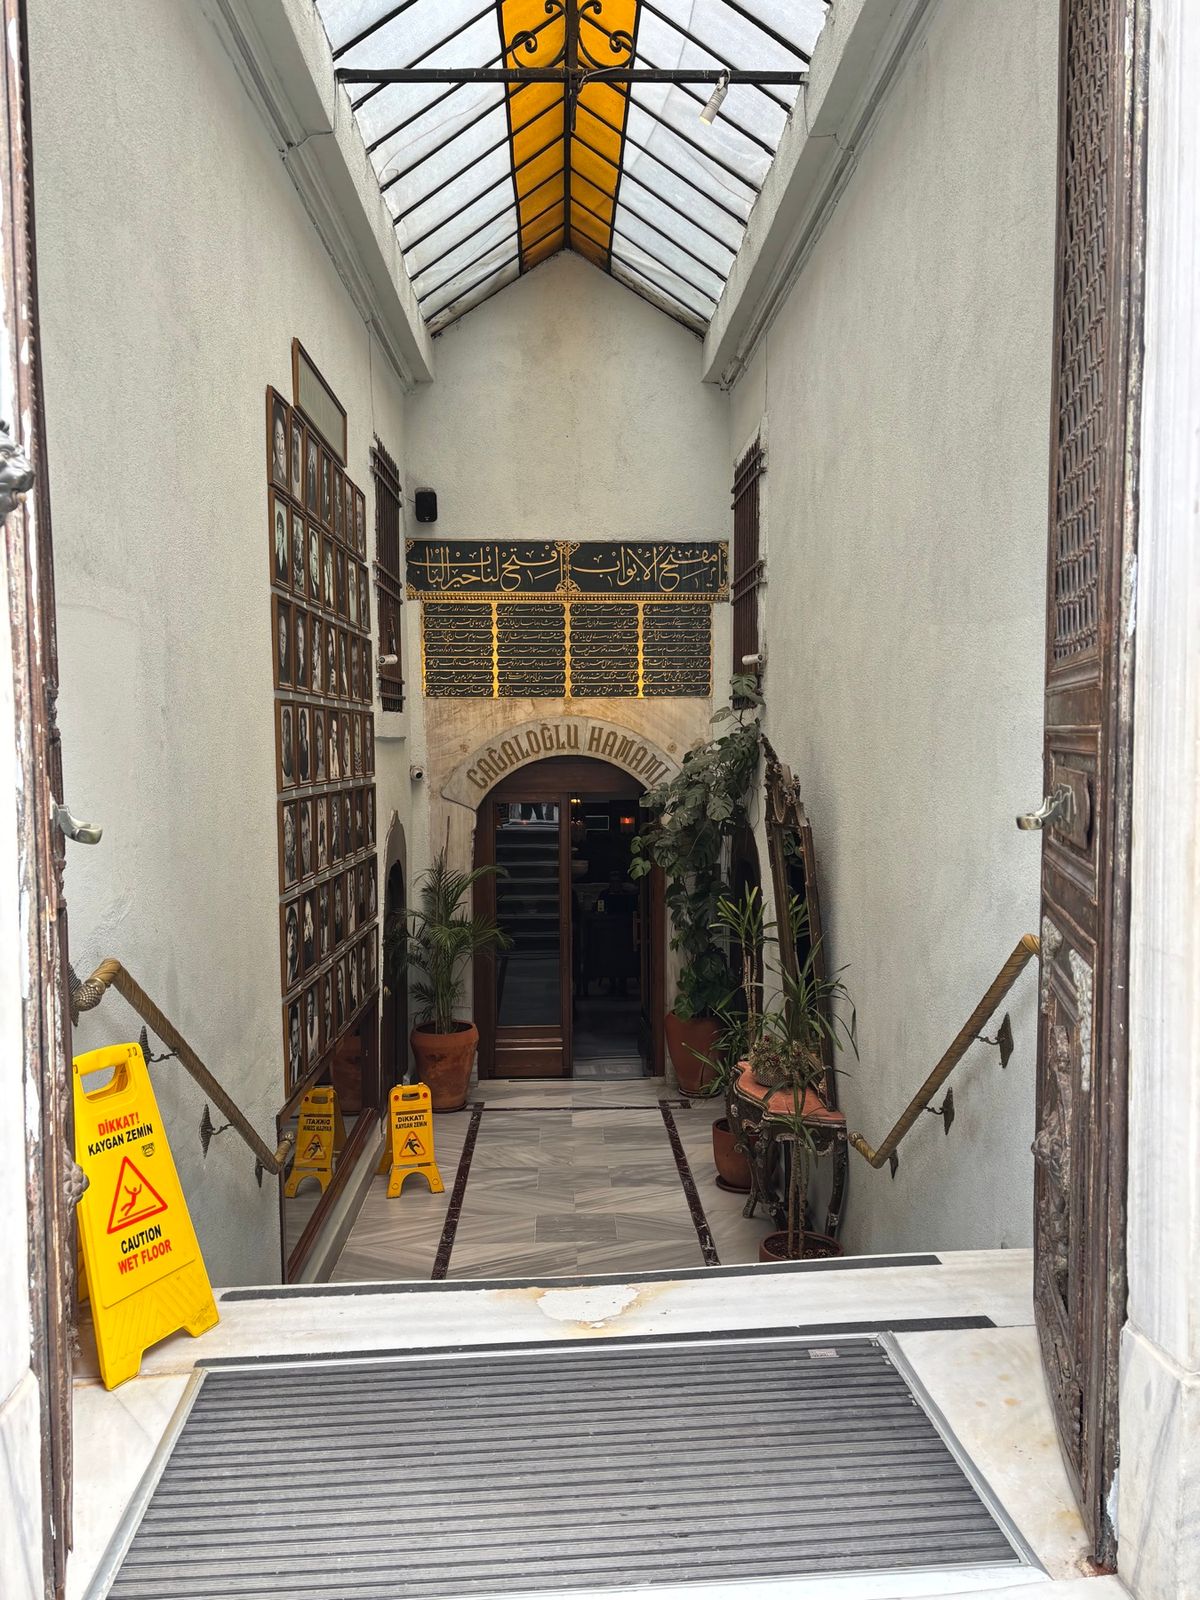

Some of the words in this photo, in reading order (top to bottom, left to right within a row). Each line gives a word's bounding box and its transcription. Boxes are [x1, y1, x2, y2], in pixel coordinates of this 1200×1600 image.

[466, 723, 580, 789] CAĞALOĞLU
[587, 726, 671, 786] HAMAMI
[88, 1133, 125, 1157] KAYGAN
[126, 1123, 154, 1143] ZEMİN
[97, 1111, 140, 1137] DİKKAT!
[120, 1224, 162, 1255] CAUTION
[118, 1255, 140, 1275] WET
[141, 1239, 173, 1265] FLOOR
